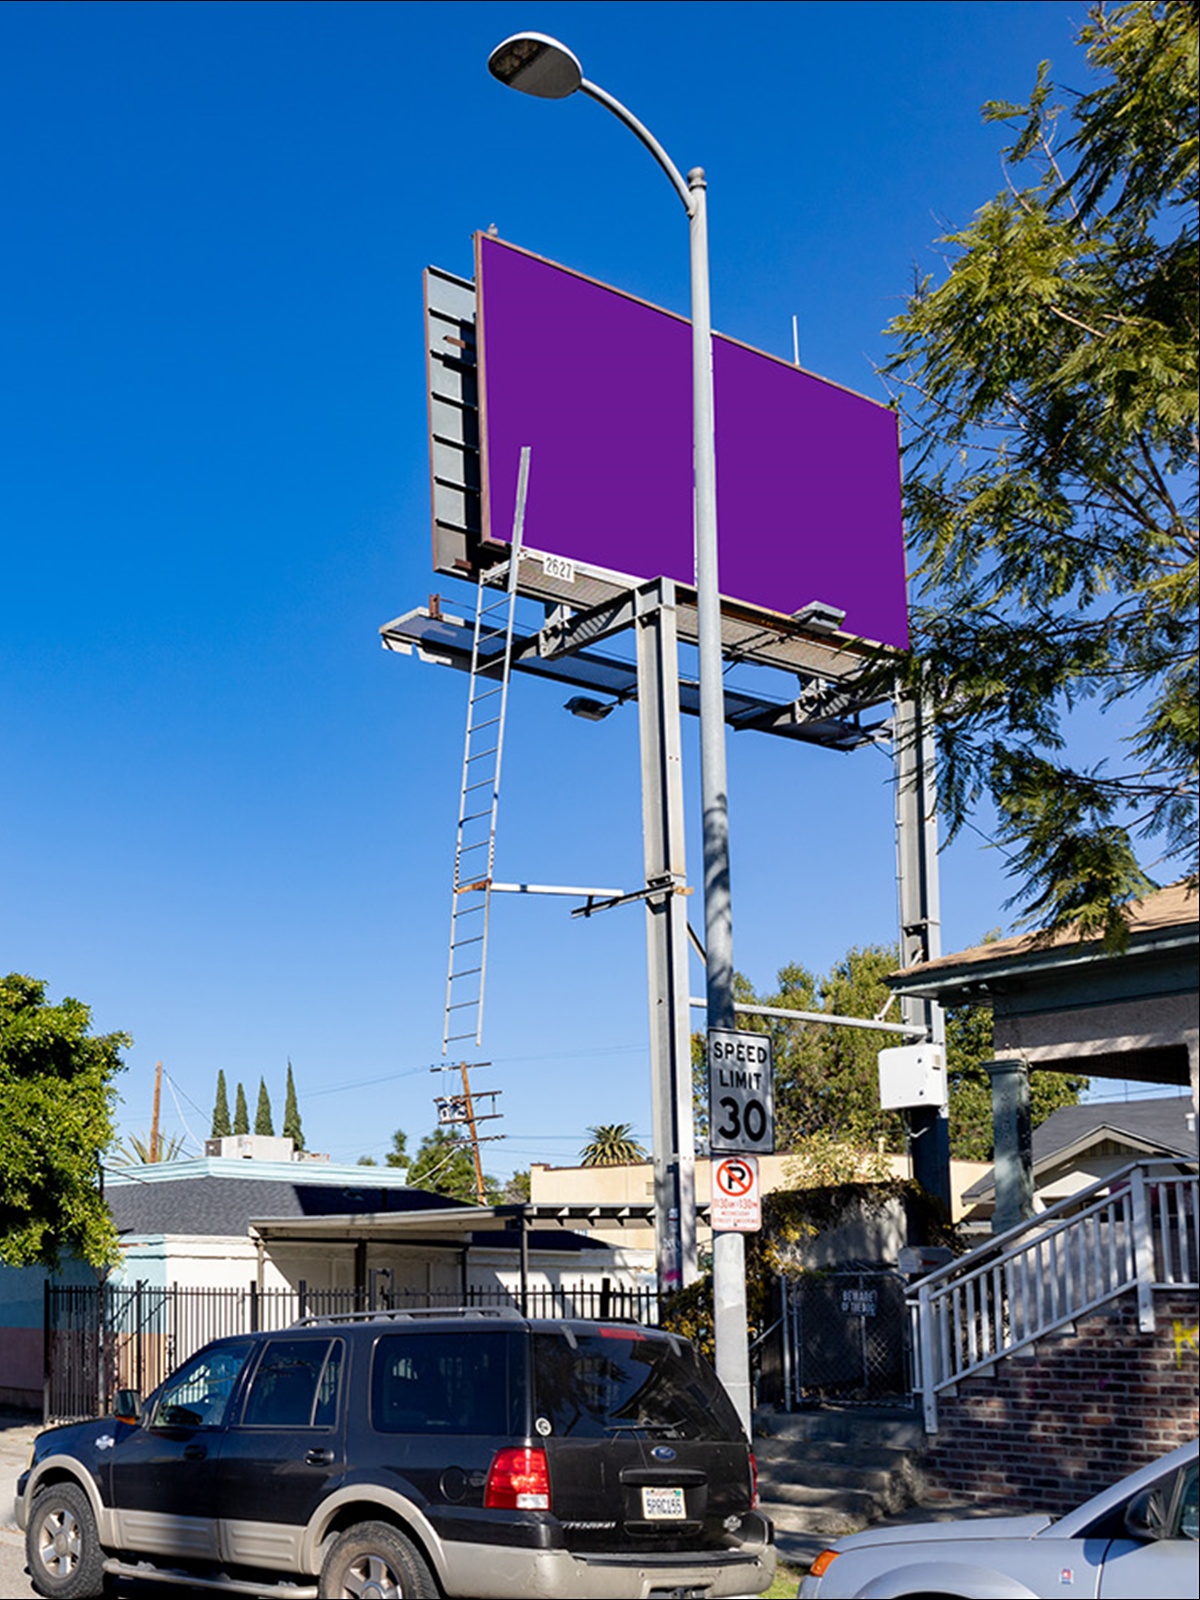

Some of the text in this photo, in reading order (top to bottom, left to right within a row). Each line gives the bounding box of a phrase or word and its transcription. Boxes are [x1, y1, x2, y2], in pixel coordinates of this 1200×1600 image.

[546, 557, 572, 579] 2627
[713, 1041, 767, 1064] SPEED
[719, 1070, 762, 1090] LIMIT
[718, 1096, 767, 1142] 30
[842, 1290, 873, 1302] BEWARE
